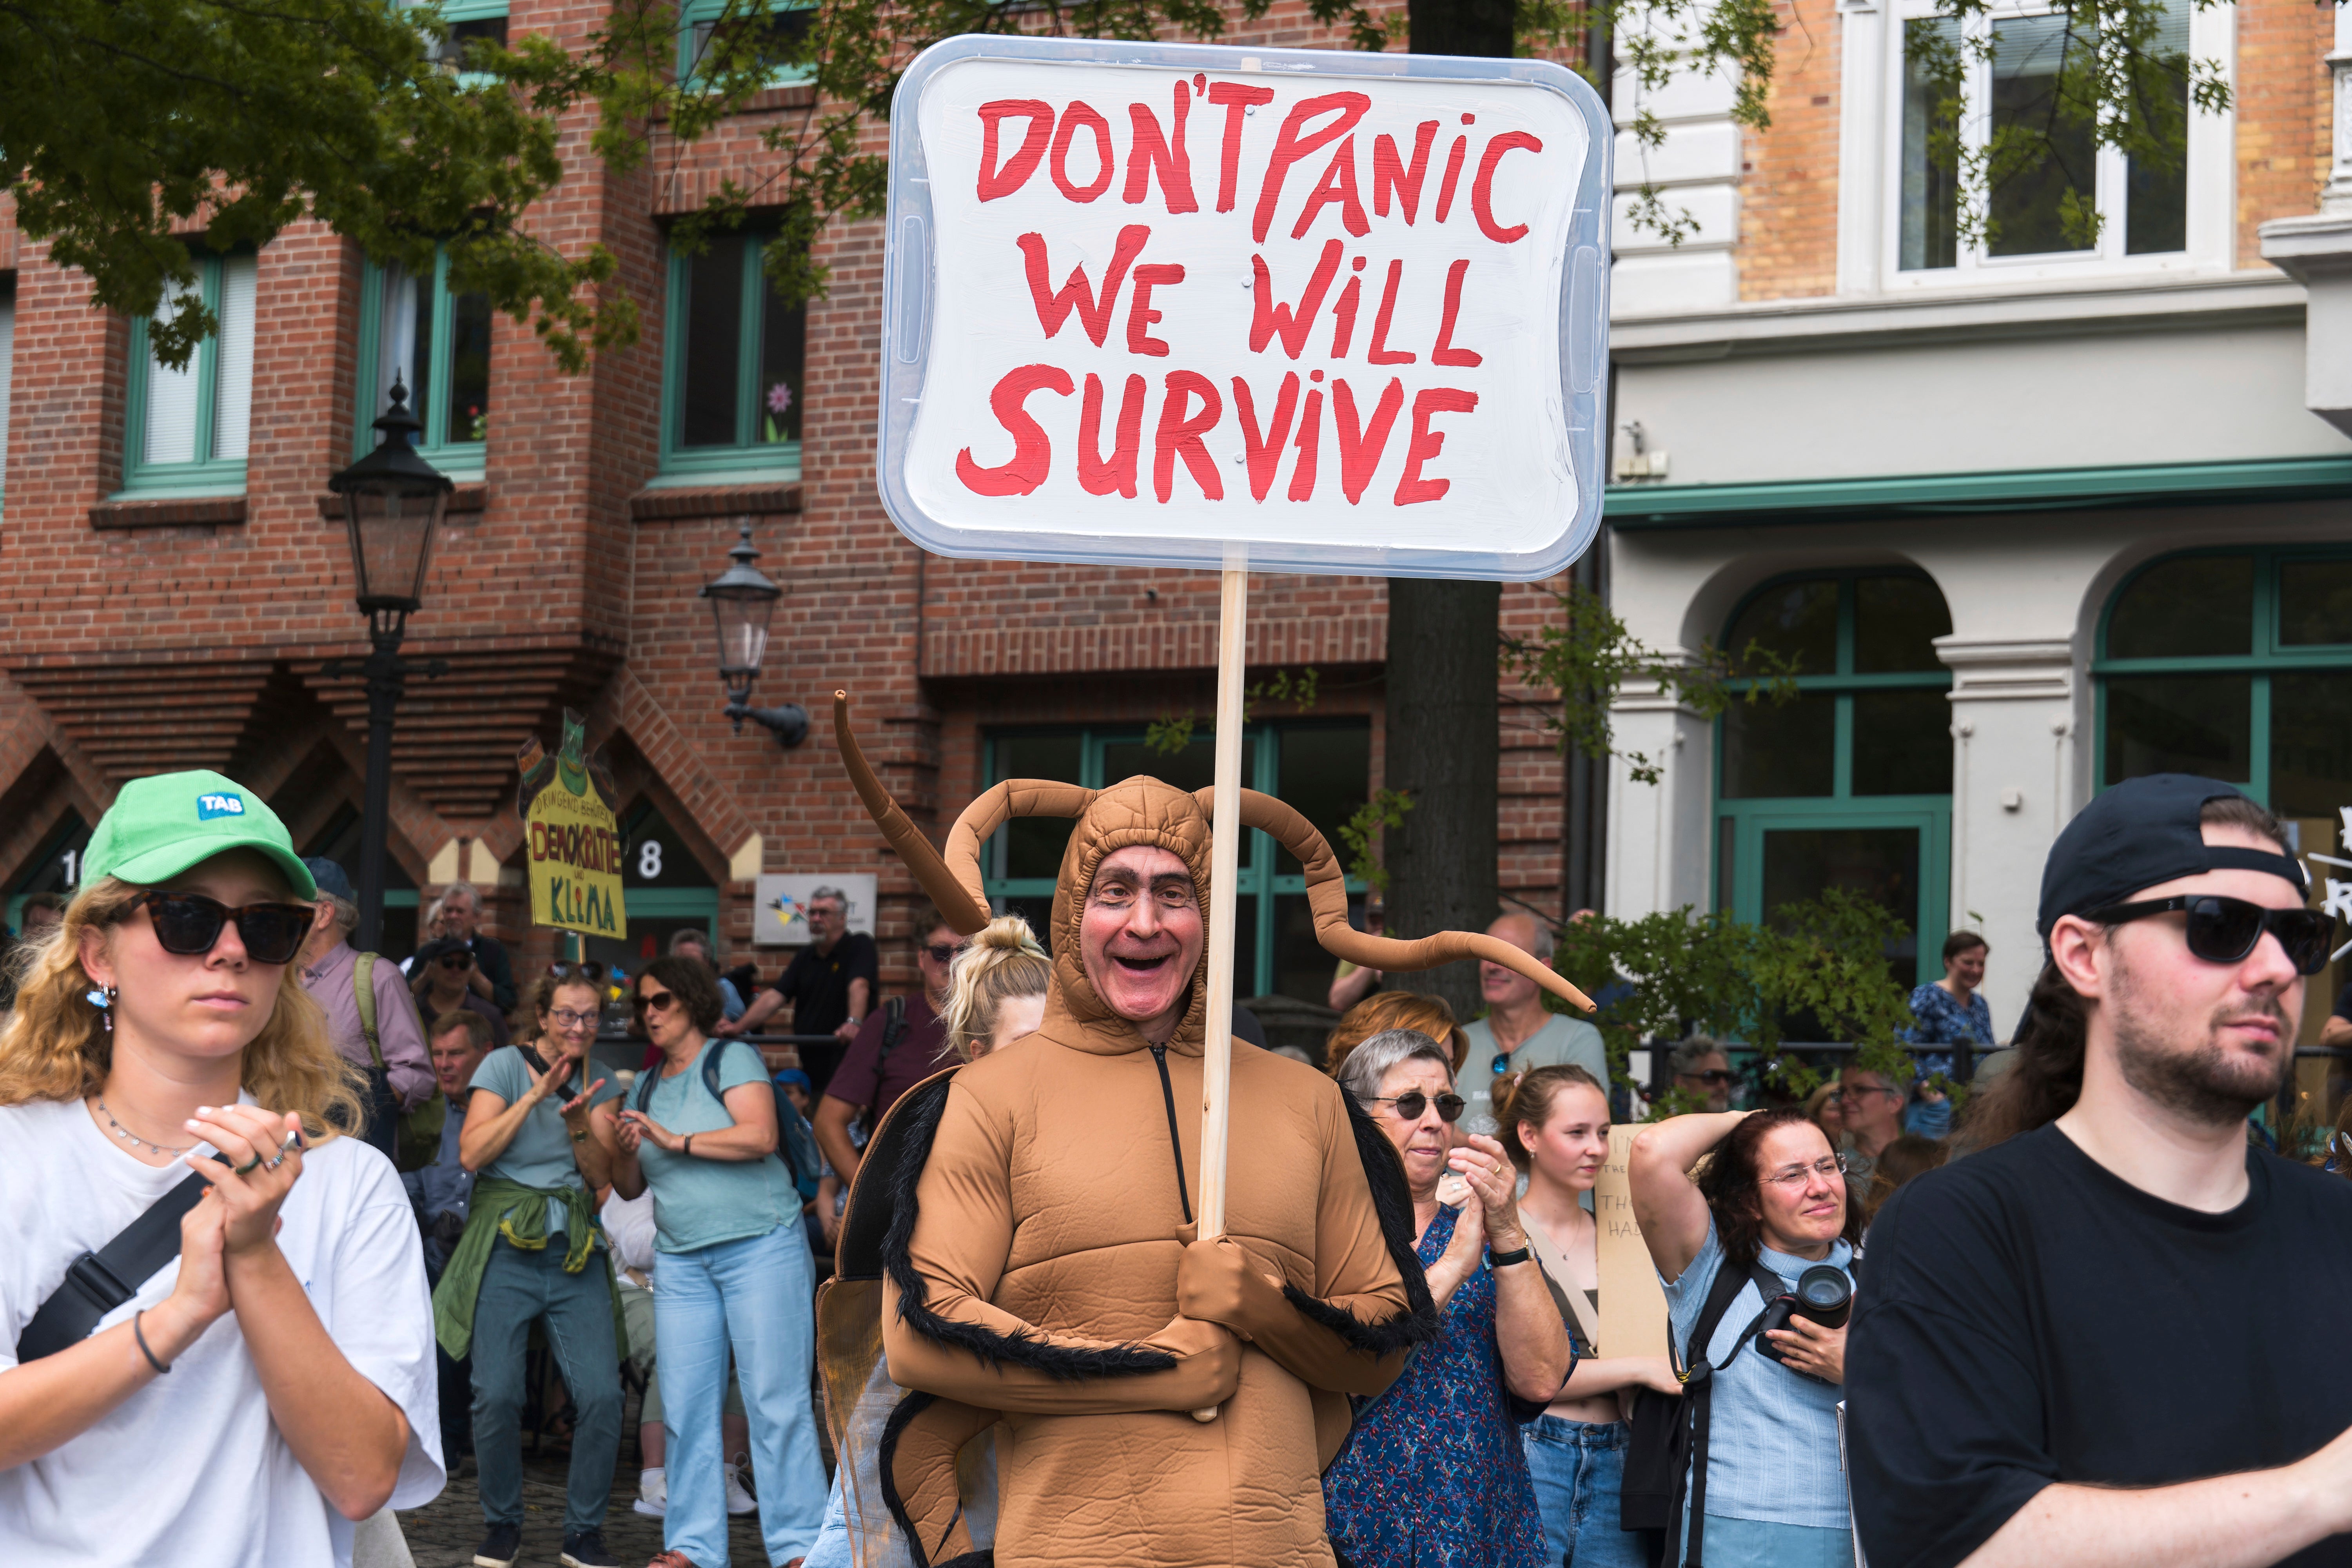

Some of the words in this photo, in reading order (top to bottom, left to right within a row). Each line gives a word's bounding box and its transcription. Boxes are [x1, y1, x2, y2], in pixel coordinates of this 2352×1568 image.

[976, 73, 1275, 214] DON'T
[1016, 224, 1186, 357] WE
[200, 795, 243, 813] TAB
[535, 790, 579, 814] DRINGEND
[532, 821, 622, 875] DEMOKRATIE
[638, 840, 662, 879] 8
[63, 849, 85, 885] 1
[574, 869, 584, 881] UND
[1603, 1165, 1626, 1173] THE
